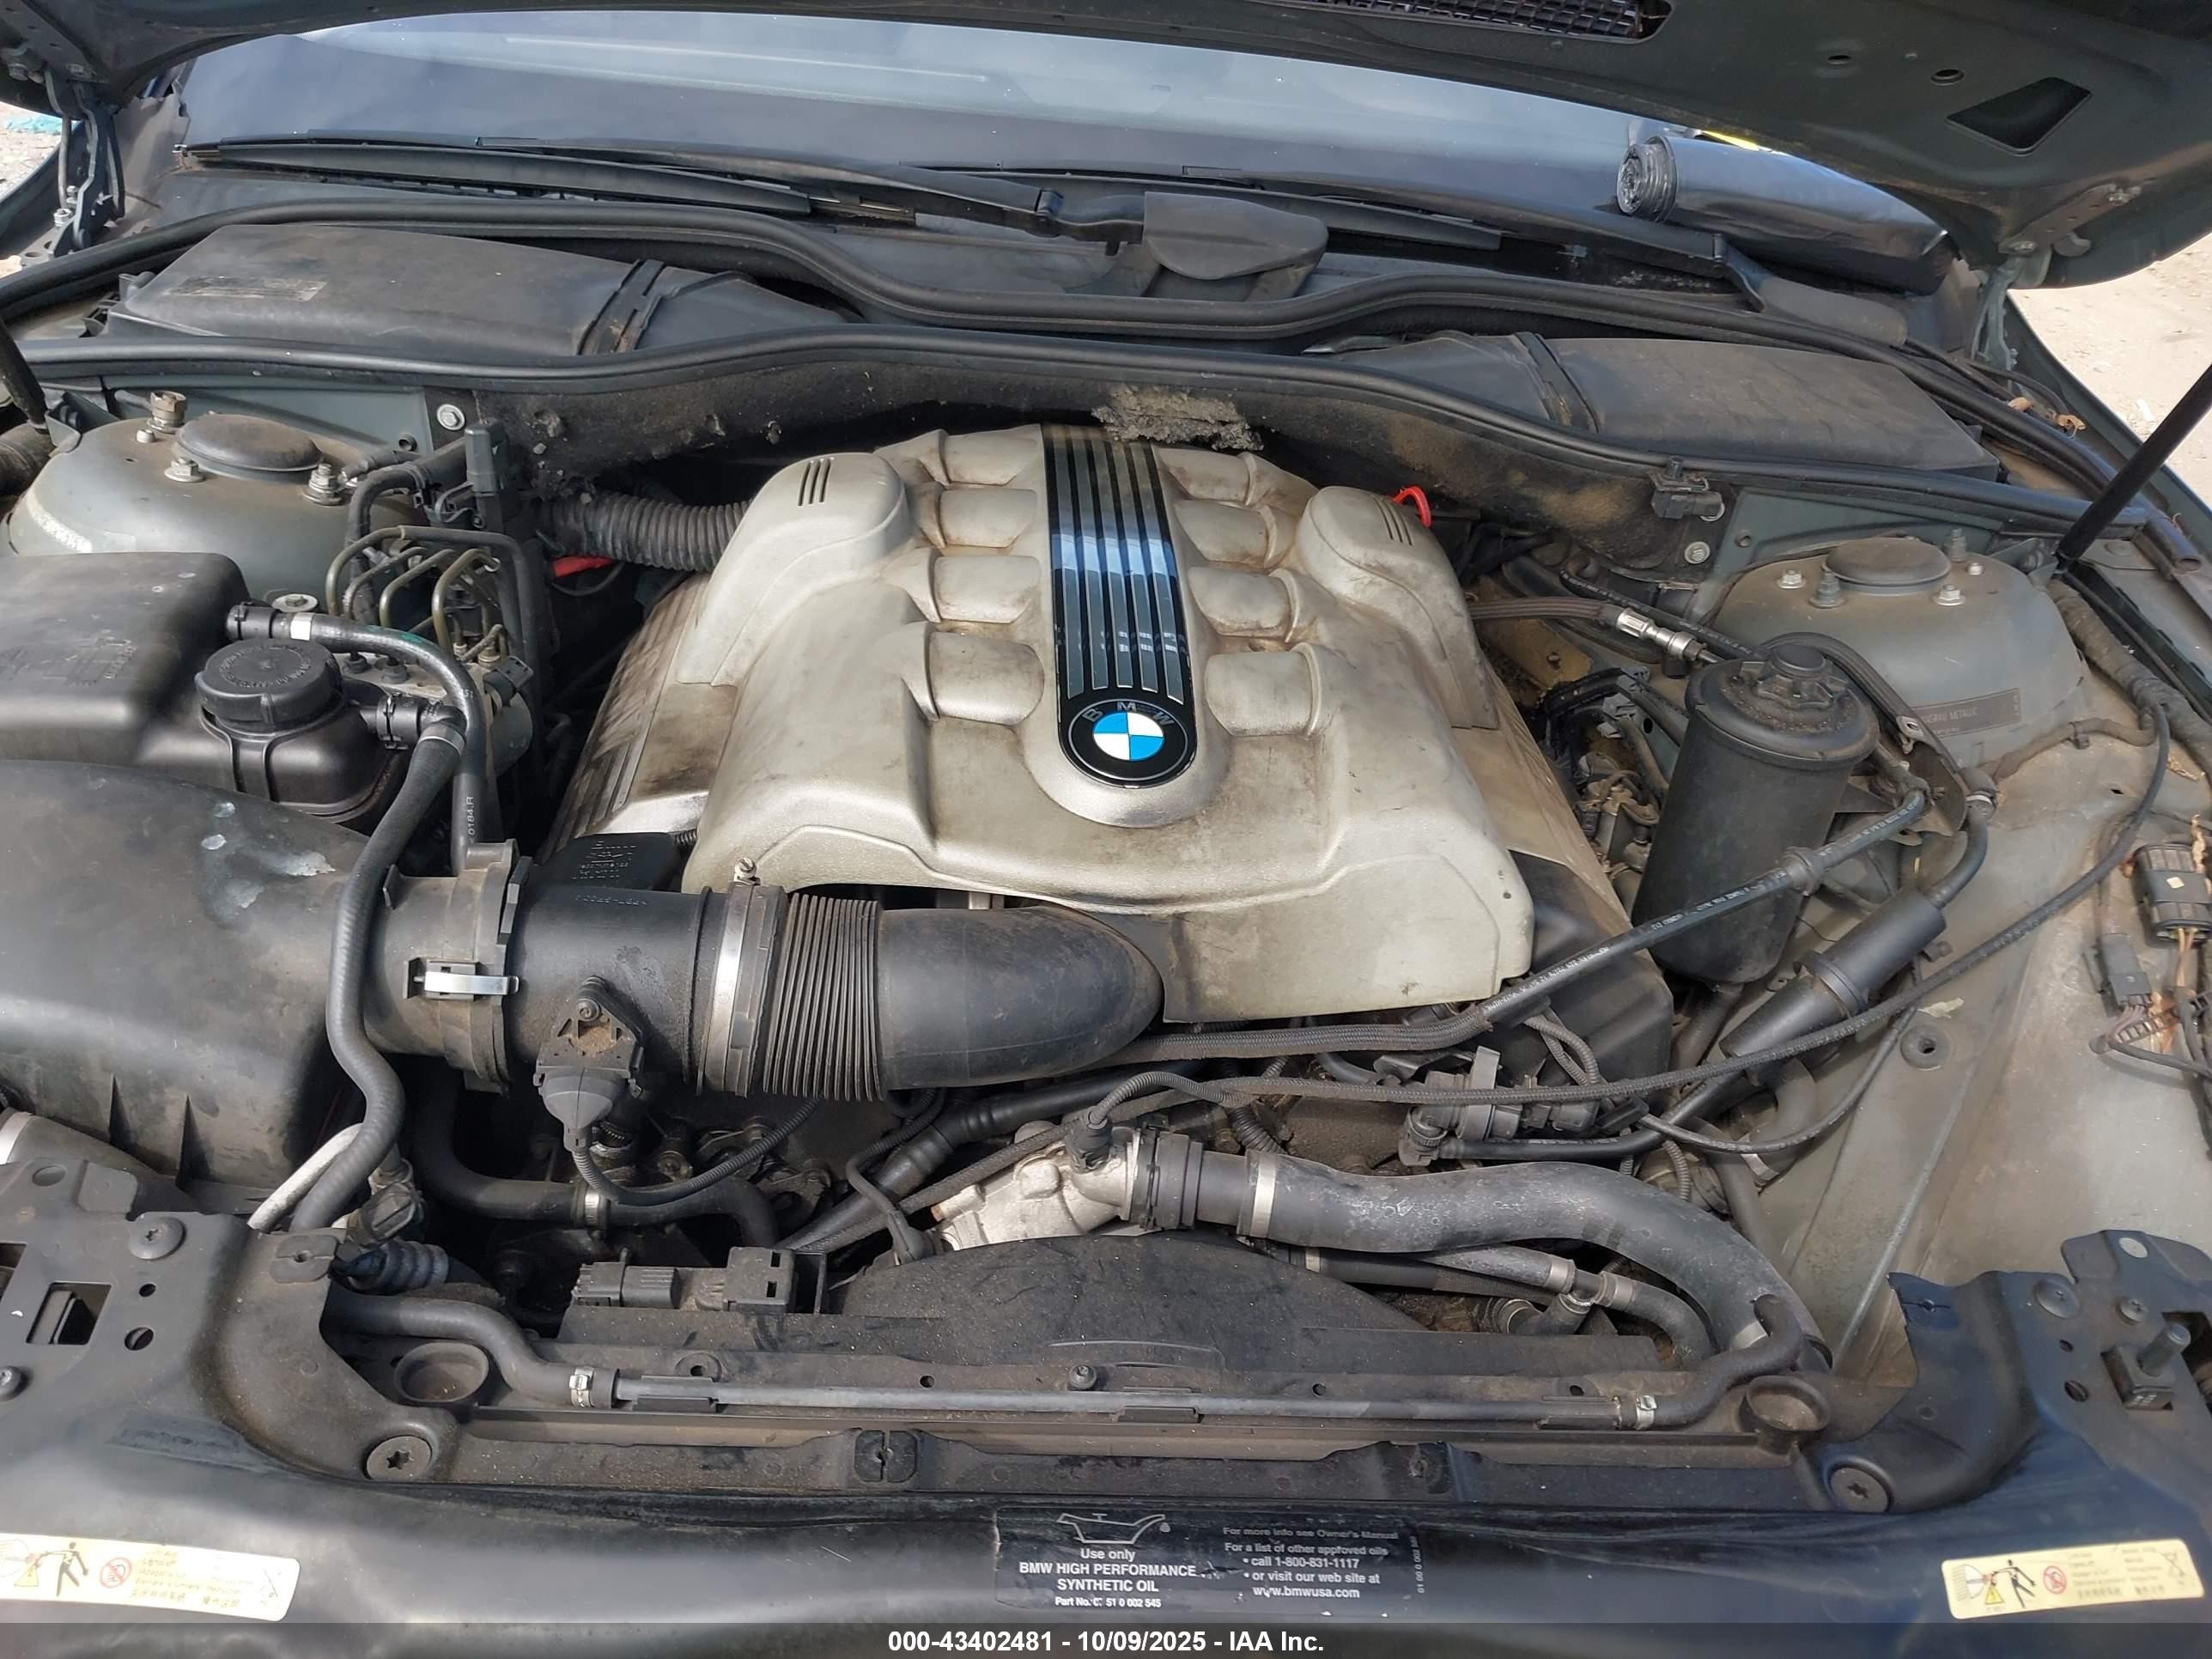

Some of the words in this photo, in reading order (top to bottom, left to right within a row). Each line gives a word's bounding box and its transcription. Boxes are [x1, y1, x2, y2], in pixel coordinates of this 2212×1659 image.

[1082, 702, 1175, 725] BMW
[1223, 1527, 1242, 1535] For
[1273, 1528, 1292, 1536] info
[1316, 1529, 1359, 1539] Owner's
[1361, 1530, 1399, 1540] Manual
[1080, 1549, 1105, 1559] Use
[1109, 1549, 1136, 1562] only
[1224, 1542, 1243, 1552] For
[1255, 1543, 1271, 1553] list
[1274, 1543, 1285, 1553] of
[1289, 1544, 1315, 1553] other
[1368, 1546, 1389, 1556] oils
[1018, 1562, 1053, 1574] BMW
[1056, 1563, 1090, 1575] HIGH
[1093, 1563, 1197, 1577] PERFORMANCE
[1250, 1557, 1272, 1567] call
[1274, 1557, 1360, 1569] 1-800-831-1117
[1251, 1572, 1265, 1581] or
[1267, 1571, 1292, 1582] visit
[1295, 1573, 1315, 1583] our
[1317, 1572, 1342, 1583] web
[1344, 1572, 1365, 1584] site
[1368, 1573, 1381, 1584] at
[1057, 1578, 1133, 1592] SYNTHETIC
[1136, 1580, 1159, 1593] OIL
[1253, 1586, 1360, 1598] www.bmwusa.com
[1055, 1596, 1073, 1607] Part
[1105, 1597, 1116, 1607] 51
[1119, 1597, 1125, 1607] 0
[1127, 1597, 1144, 1608] 002
[1145, 1598, 1162, 1608] 545
